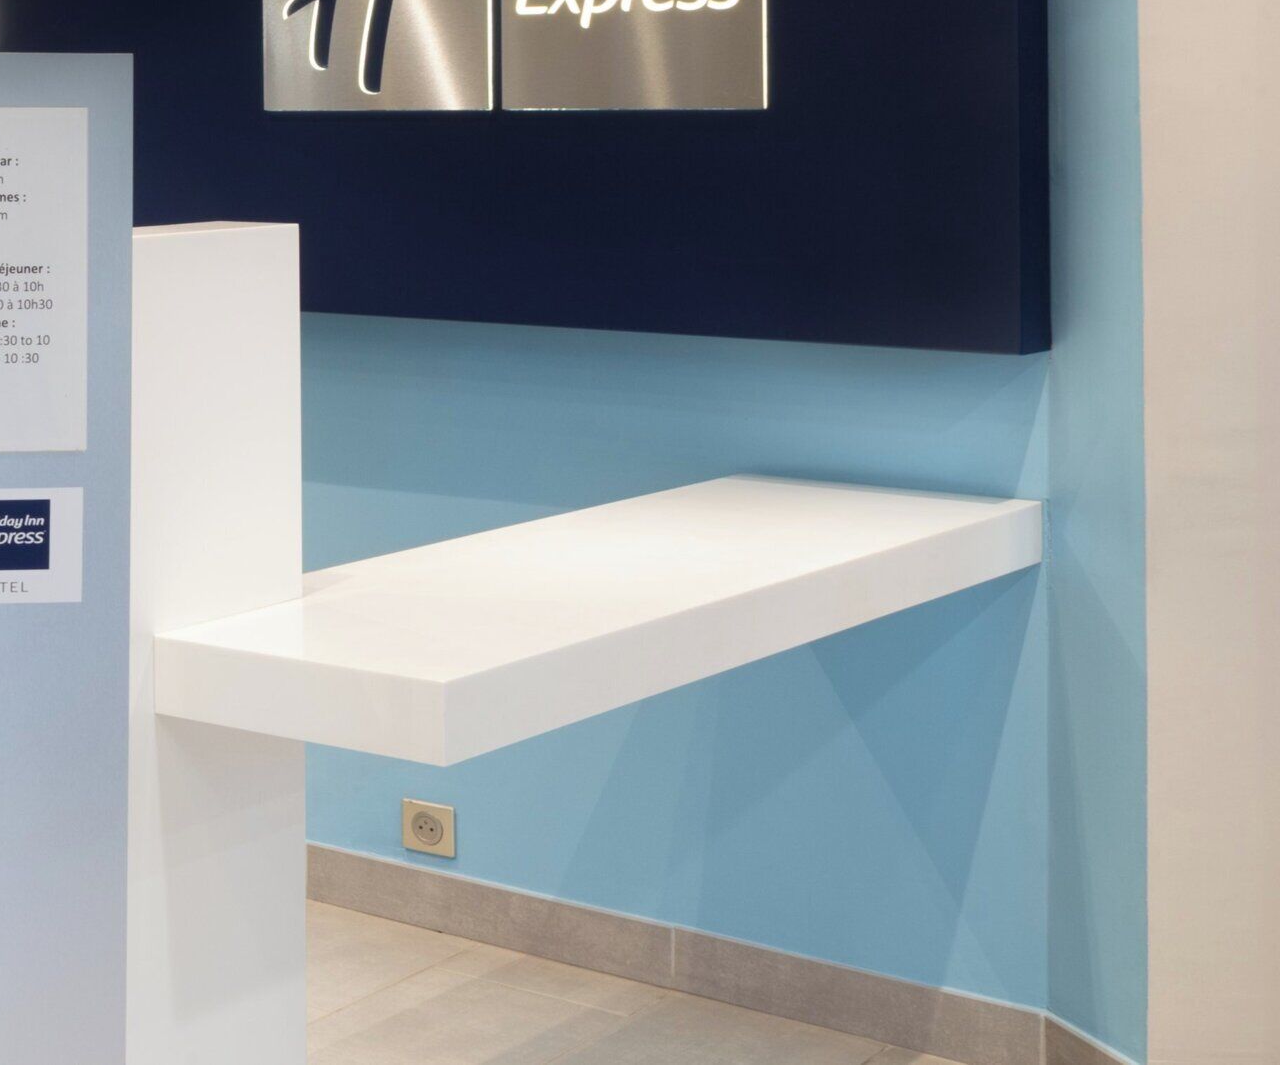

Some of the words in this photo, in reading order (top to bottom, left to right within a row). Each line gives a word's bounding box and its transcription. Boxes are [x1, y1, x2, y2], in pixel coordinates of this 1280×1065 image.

[12, 280, 20, 293] à
[23, 281, 45, 293] 10h
[6, 298, 14, 311] à
[17, 298, 54, 311] 10h30
[20, 335, 33, 346] to
[36, 334, 51, 346] 10
[4, 352, 19, 364] 10
[21, 352, 40, 364] :30
[24, 514, 45, 526] Inn
